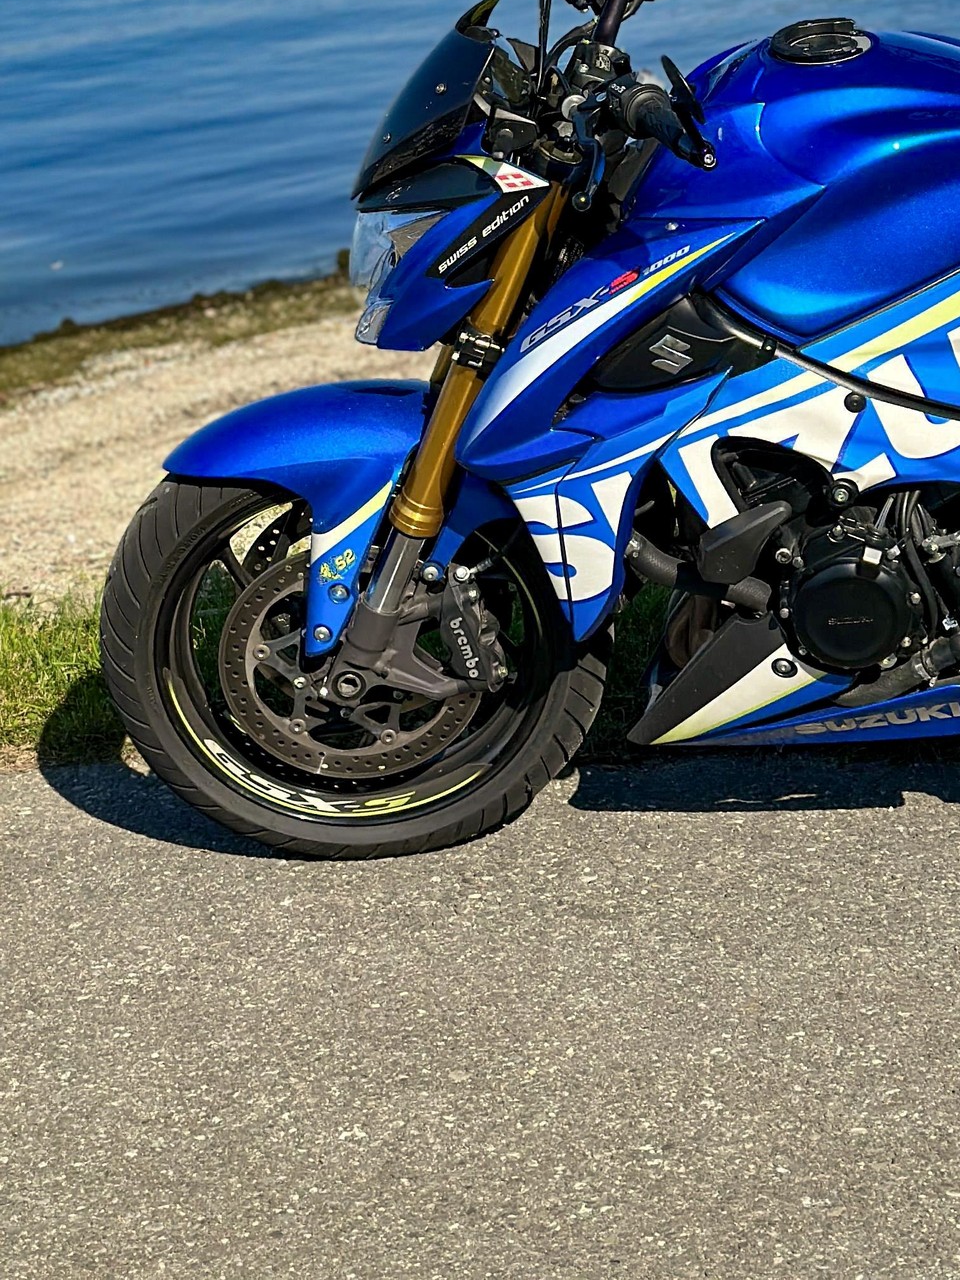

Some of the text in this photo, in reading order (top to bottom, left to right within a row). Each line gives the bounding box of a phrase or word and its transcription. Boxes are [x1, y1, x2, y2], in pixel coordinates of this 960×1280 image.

[438, 195, 530, 274] swiss edition
[449, 616, 480, 679] brembo
[203, 738, 416, 814] GSX-S
